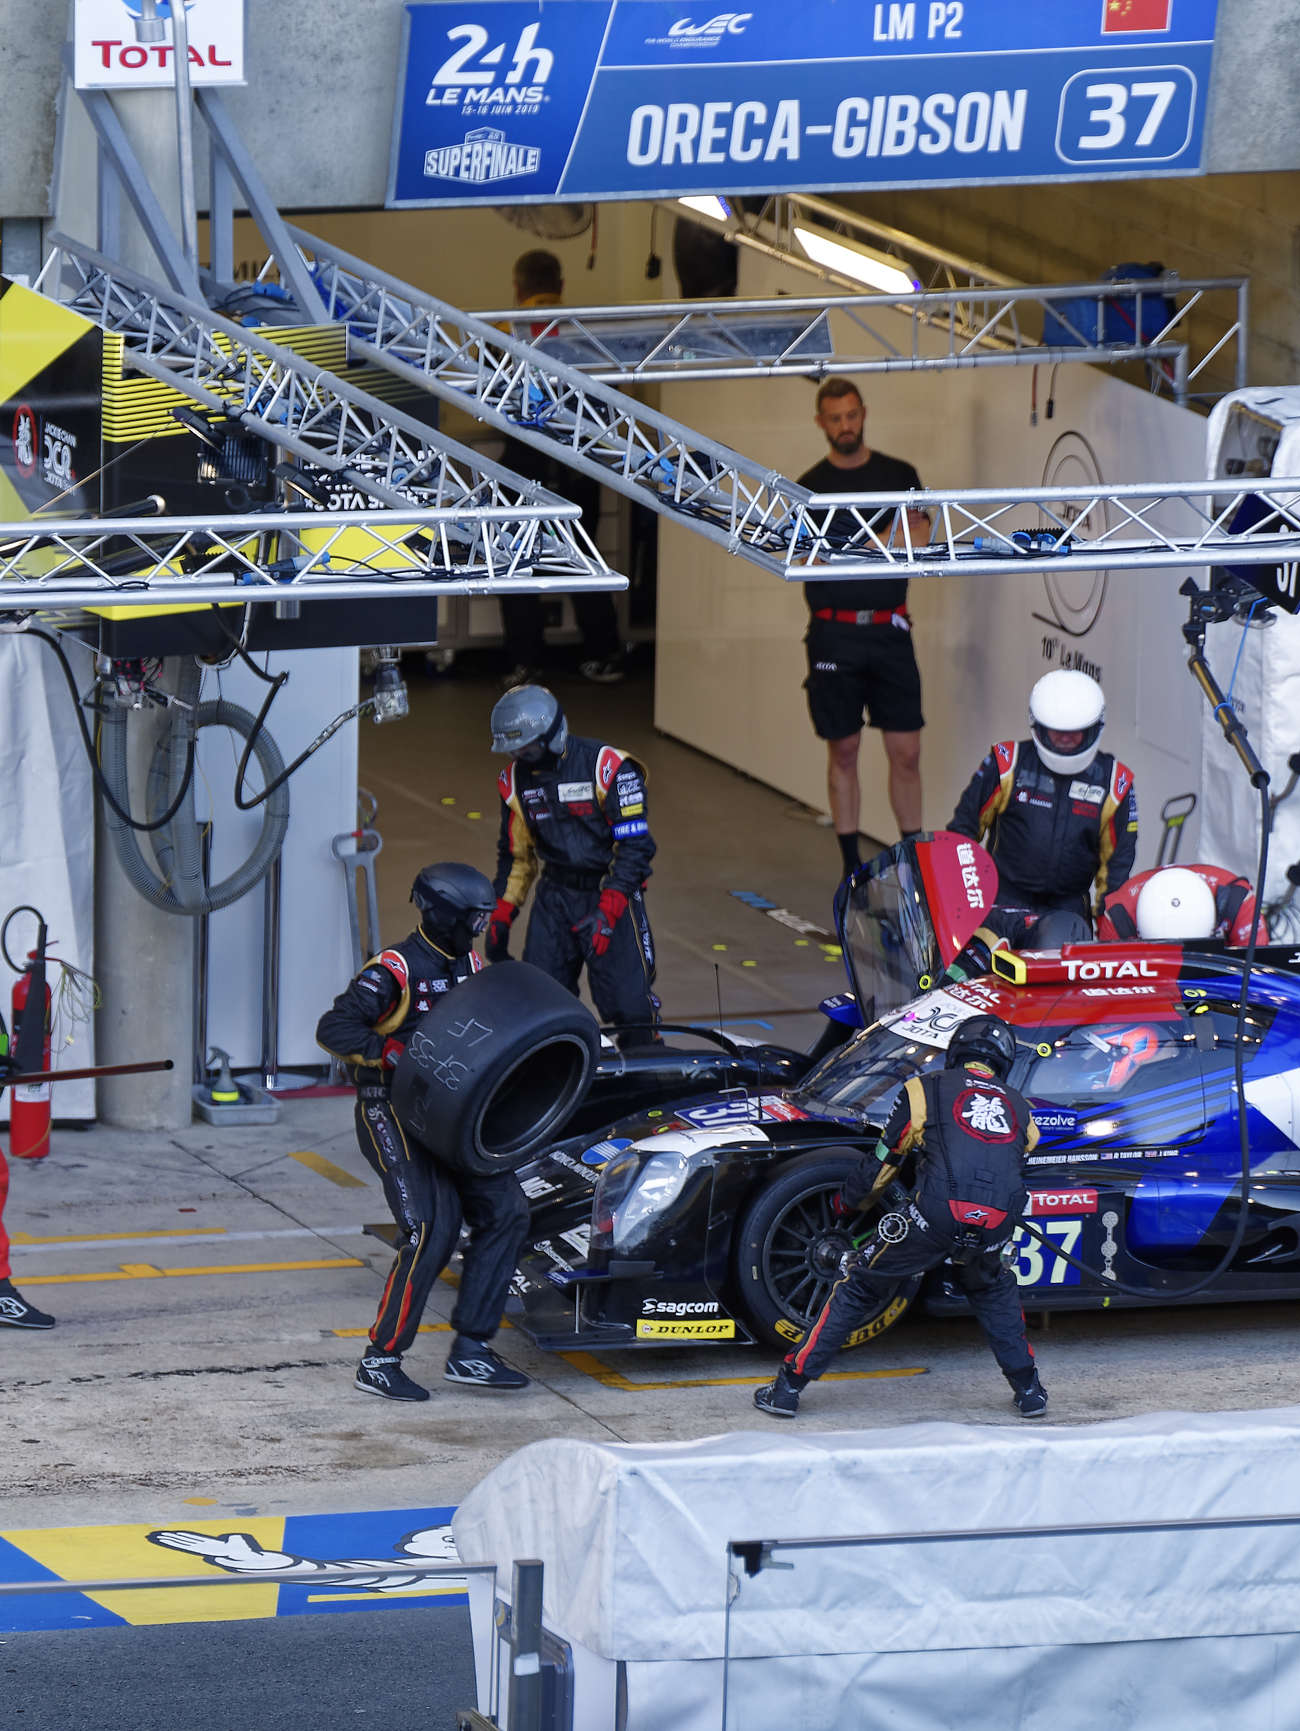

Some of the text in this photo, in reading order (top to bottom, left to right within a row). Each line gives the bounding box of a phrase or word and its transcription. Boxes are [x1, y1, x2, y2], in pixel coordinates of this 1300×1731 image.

[668, 13, 753, 36] WEC
[873, 1, 964, 42] LM P2
[91, 40, 232, 69] TOTAL
[432, 22, 554, 86] 24h
[426, 87, 462, 105] LE
[625, 89, 1028, 168] ORECA-GIBSON
[1077, 81, 1177, 149] 37
[426, 142, 539, 181] SUPERFINALE
[1061, 960, 1158, 981] TOTAL
[1033, 1193, 1095, 1207] TOTAL
[1010, 1219, 1082, 1286] 37
[656, 1301, 720, 1316] sagcom
[656, 1324, 730, 1334] DUNLOP
